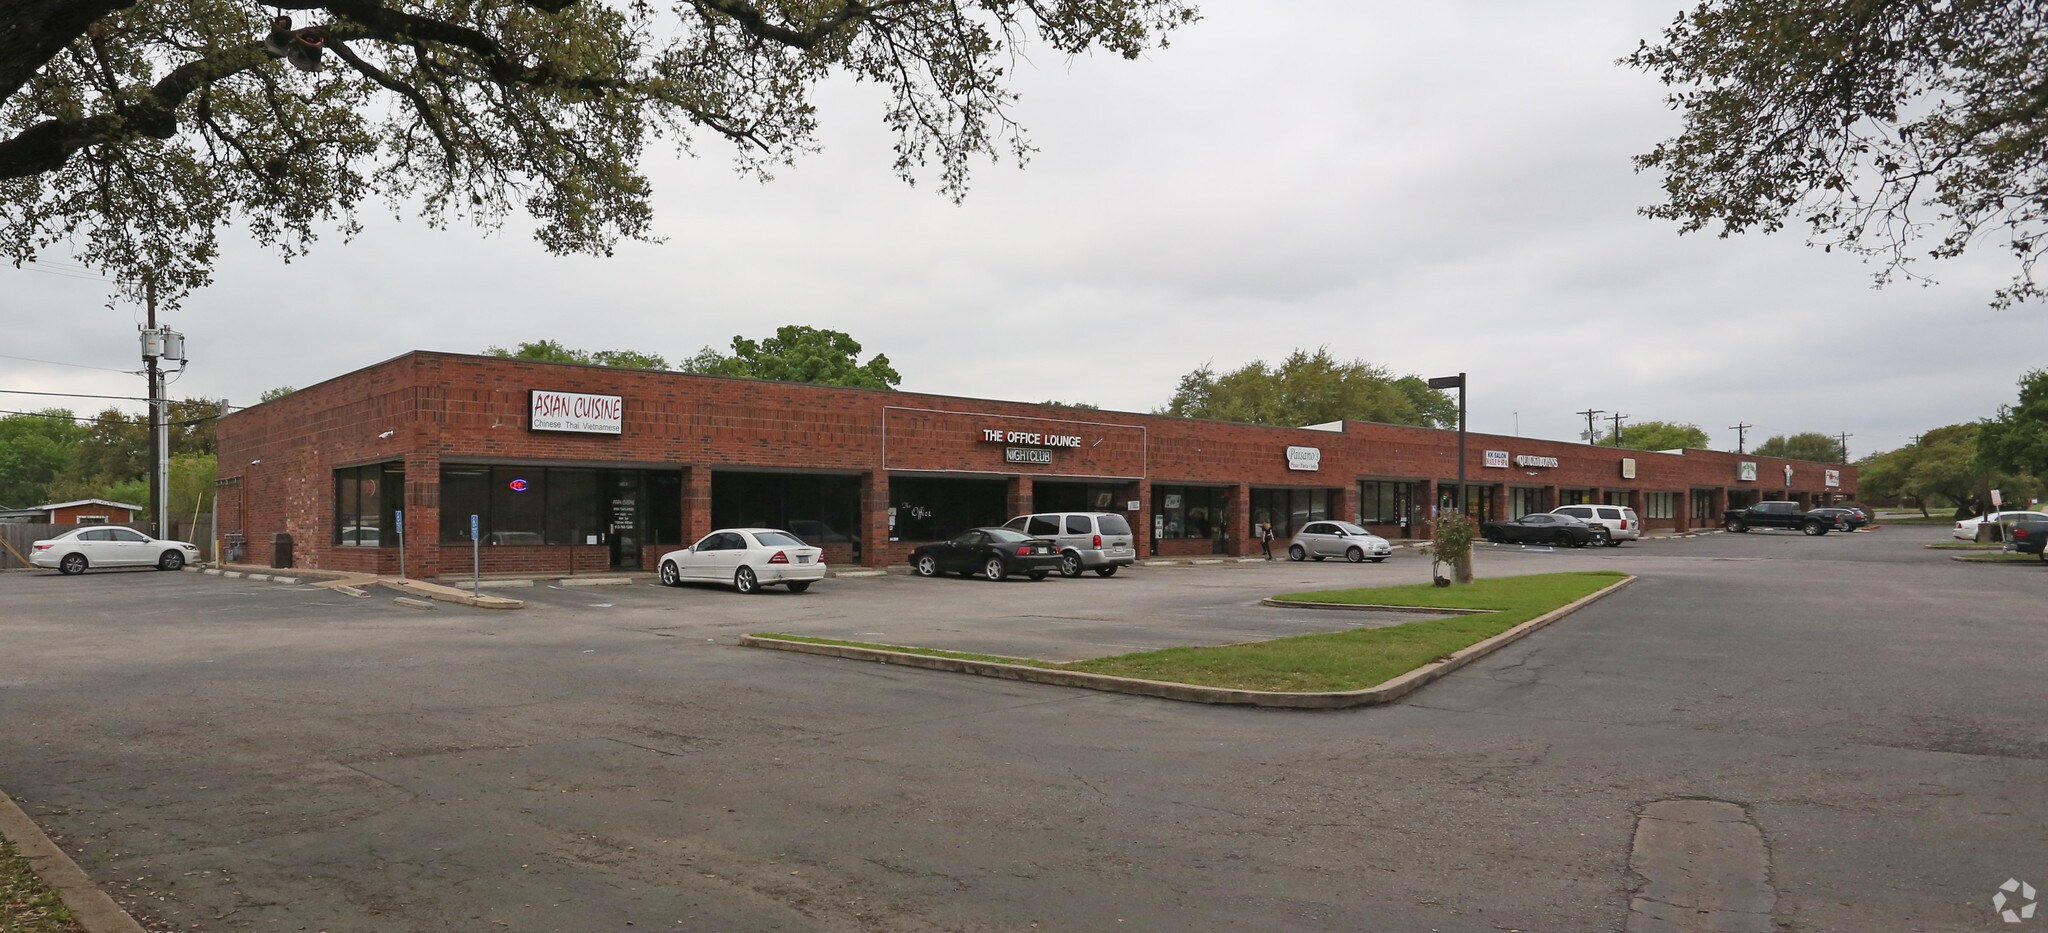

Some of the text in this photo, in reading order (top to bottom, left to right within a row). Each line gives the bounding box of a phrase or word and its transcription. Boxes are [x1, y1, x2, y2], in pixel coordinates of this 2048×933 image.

[534, 393, 621, 420] ASIAN CUISINE
[534, 419, 620, 432] Chinese Thai Vietnamese
[983, 429, 1082, 448] THE OFFICE LOUNGE
[1006, 449, 1051, 463] NIGHTCLUB
